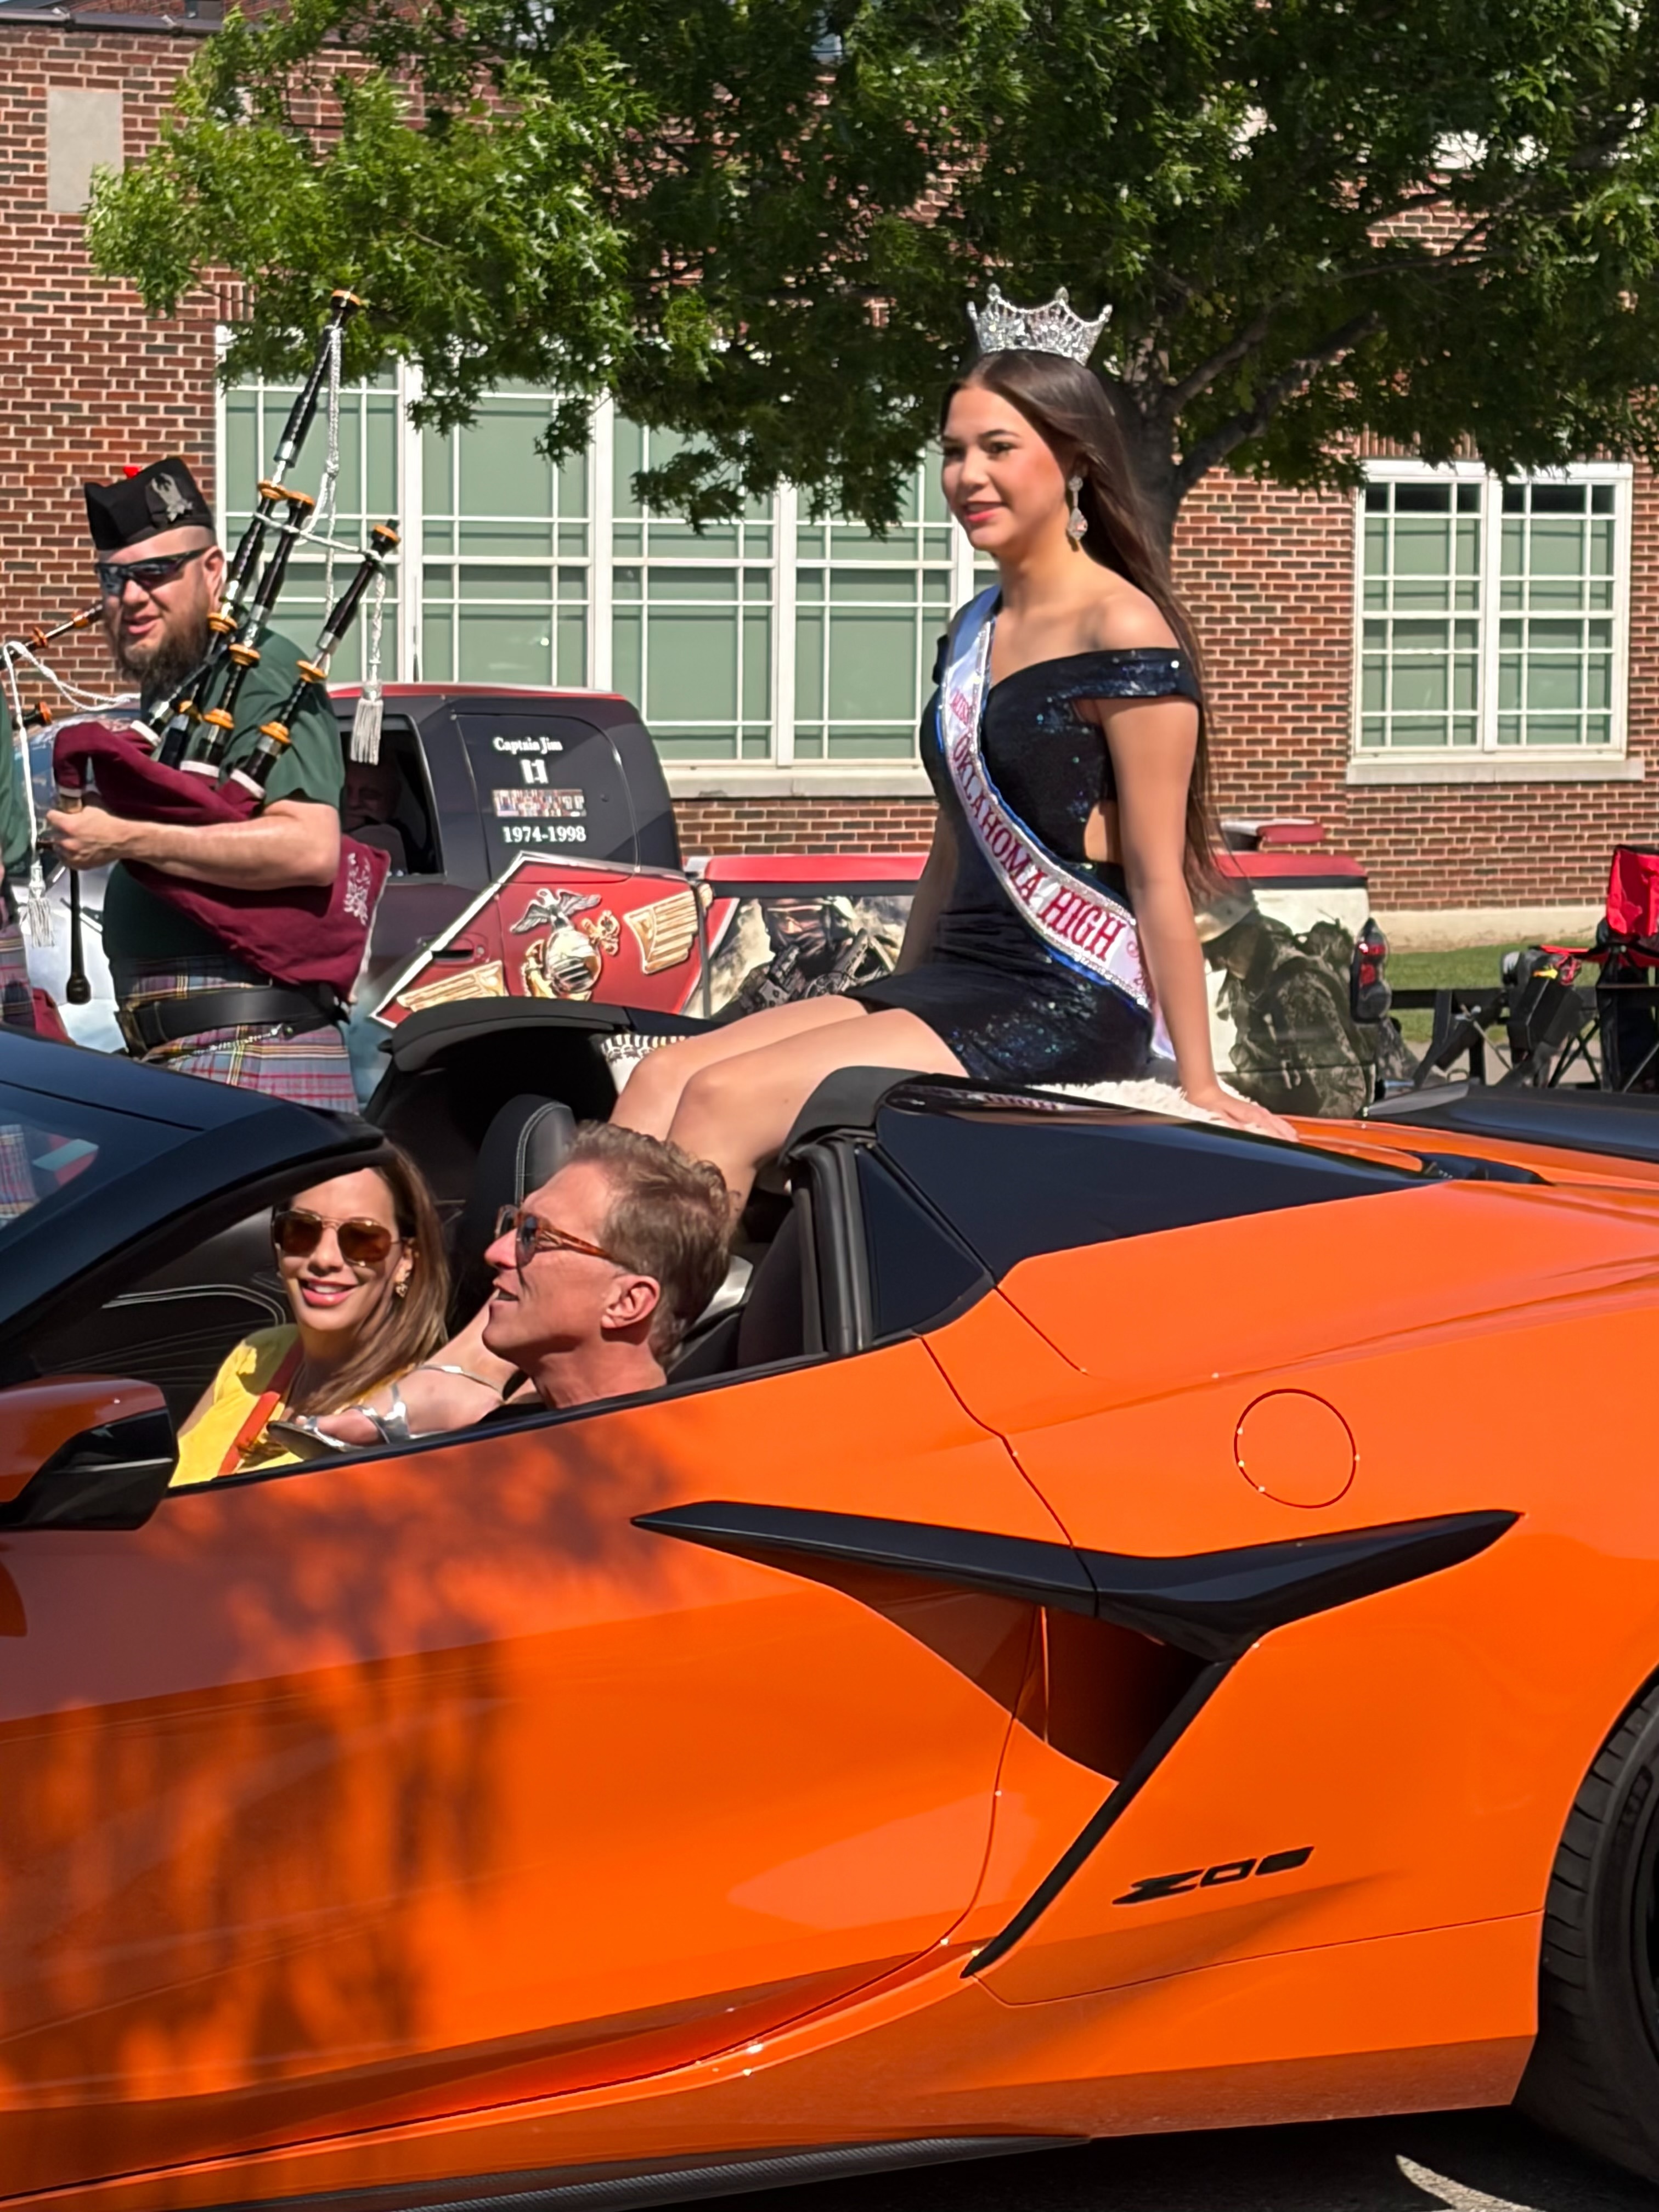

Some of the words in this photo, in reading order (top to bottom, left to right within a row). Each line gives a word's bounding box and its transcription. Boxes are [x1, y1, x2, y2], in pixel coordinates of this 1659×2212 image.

[493, 737, 540, 755] Captain
[539, 737, 563, 754] Jim
[503, 826, 587, 843] 1974-1998
[953, 733, 1048, 905] OKLAHOMA
[1036, 885, 1127, 962] HIGH
